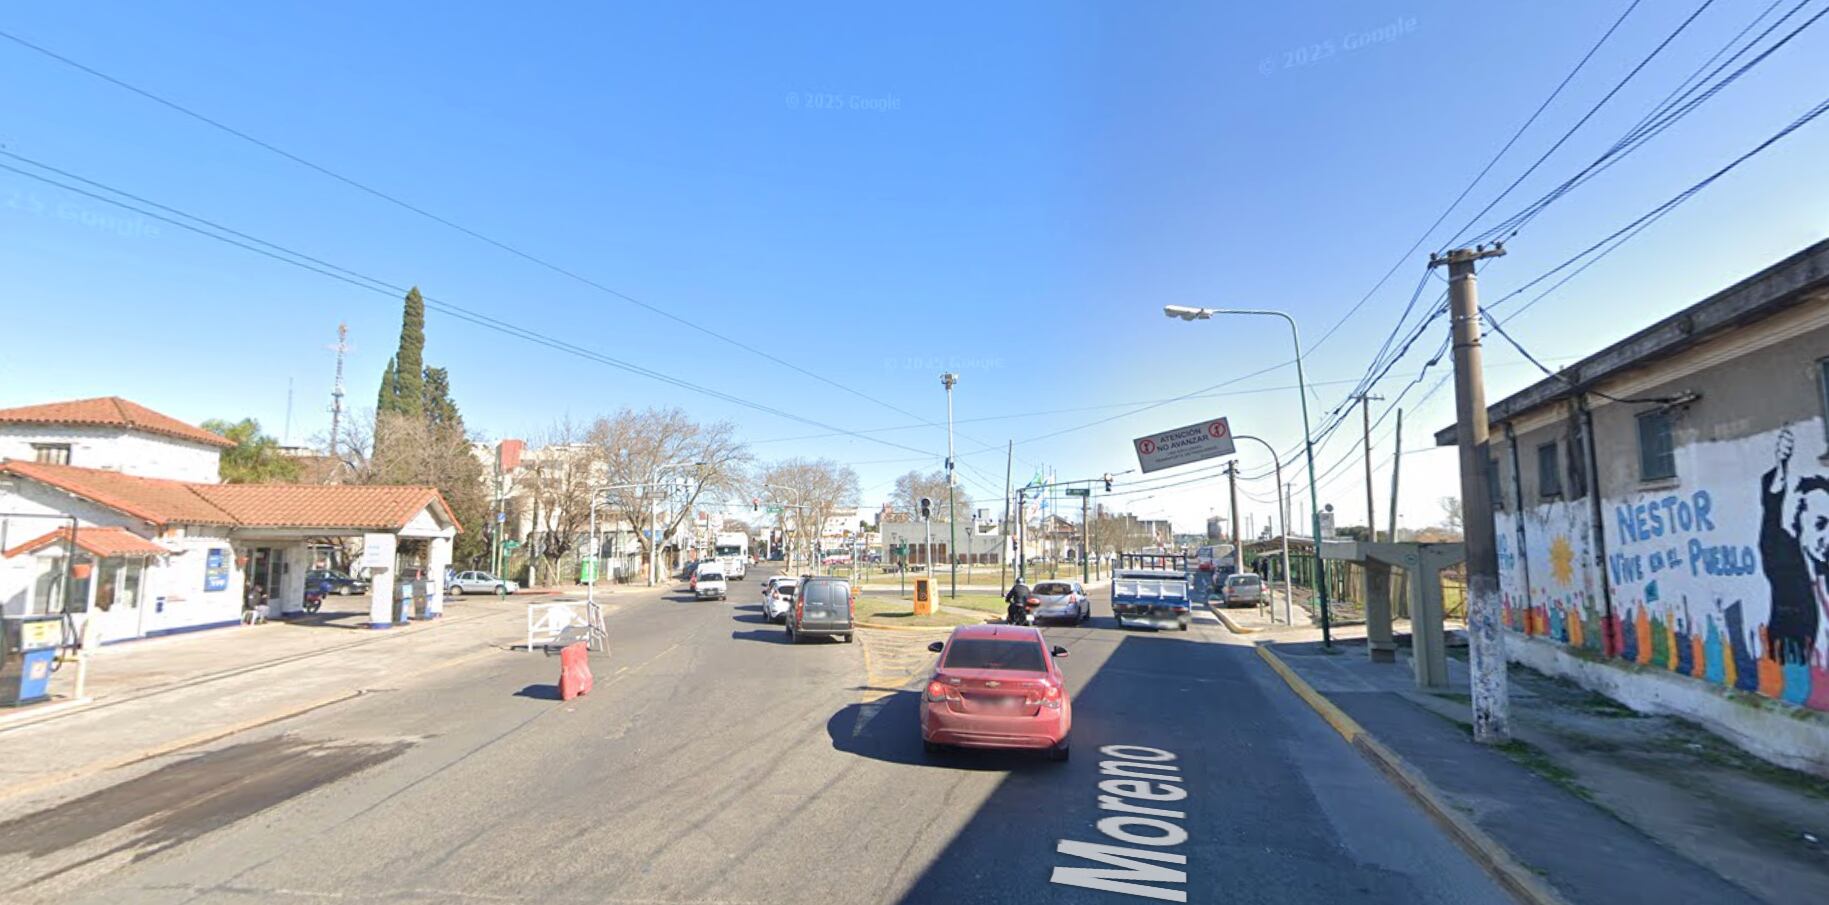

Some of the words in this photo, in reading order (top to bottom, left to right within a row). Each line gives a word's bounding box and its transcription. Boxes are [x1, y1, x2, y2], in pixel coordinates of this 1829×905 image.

[1157, 445, 1170, 453] NO
[1171, 434, 1209, 448] AVANZAR
[1160, 428, 1202, 443] ATENCIÓN
[1050, 744, 1189, 903] Moreno
